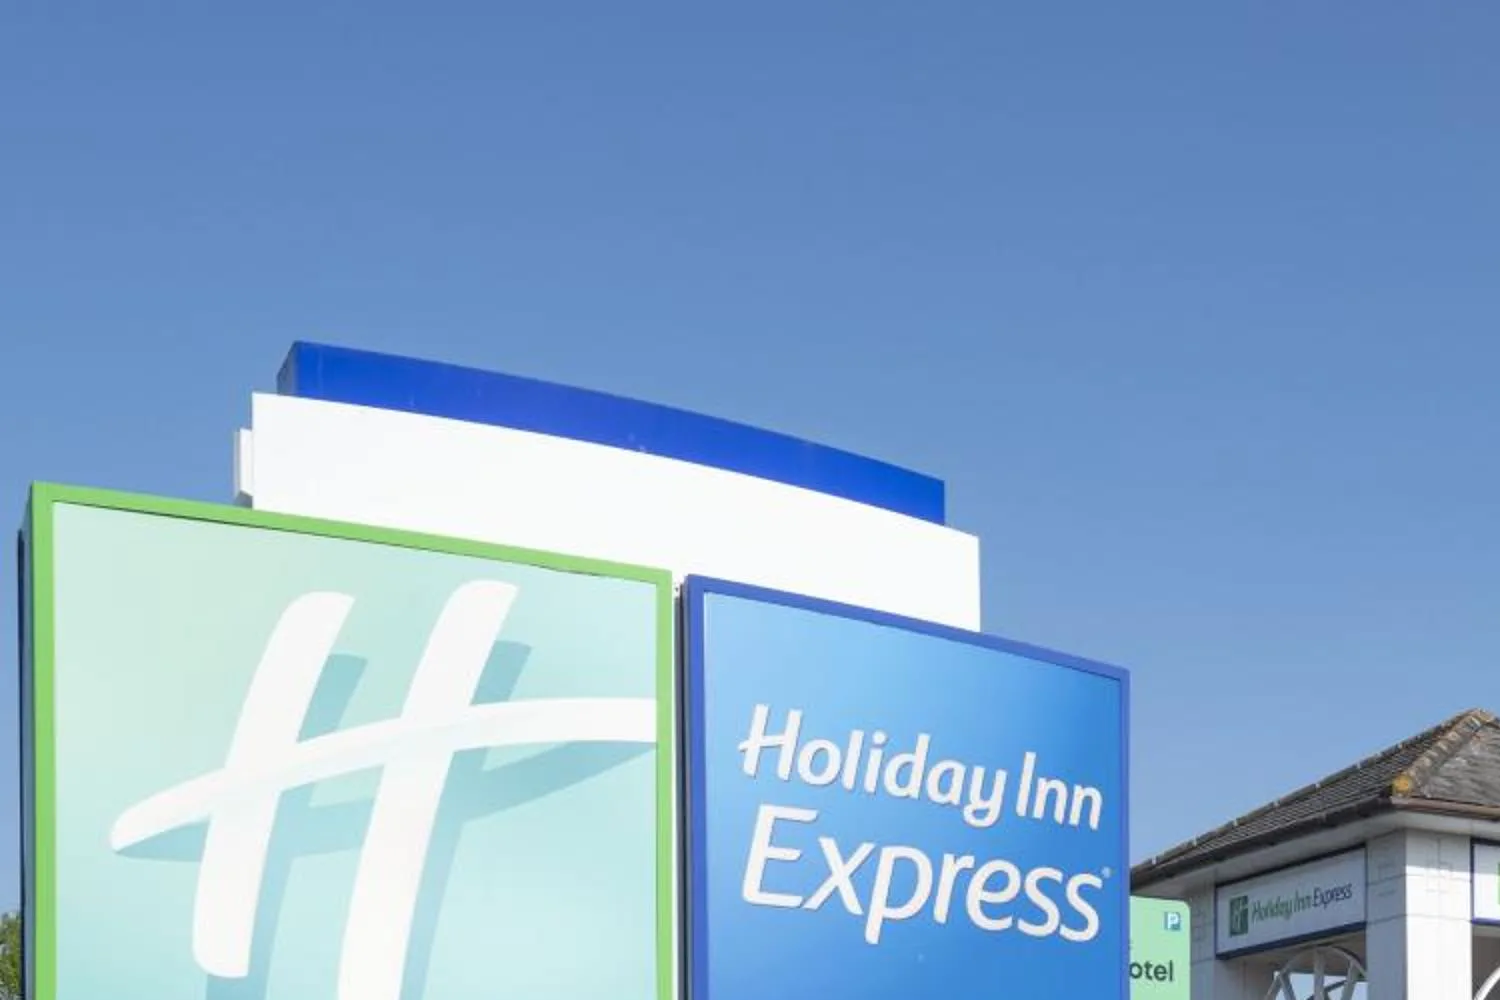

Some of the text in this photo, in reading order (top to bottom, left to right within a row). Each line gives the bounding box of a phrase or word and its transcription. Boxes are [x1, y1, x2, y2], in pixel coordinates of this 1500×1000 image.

[737, 702, 1103, 831] Holiday Inn
[741, 803, 1103, 945] Express
[1312, 883, 1353, 910] Express
[1129, 960, 1173, 982] otel
